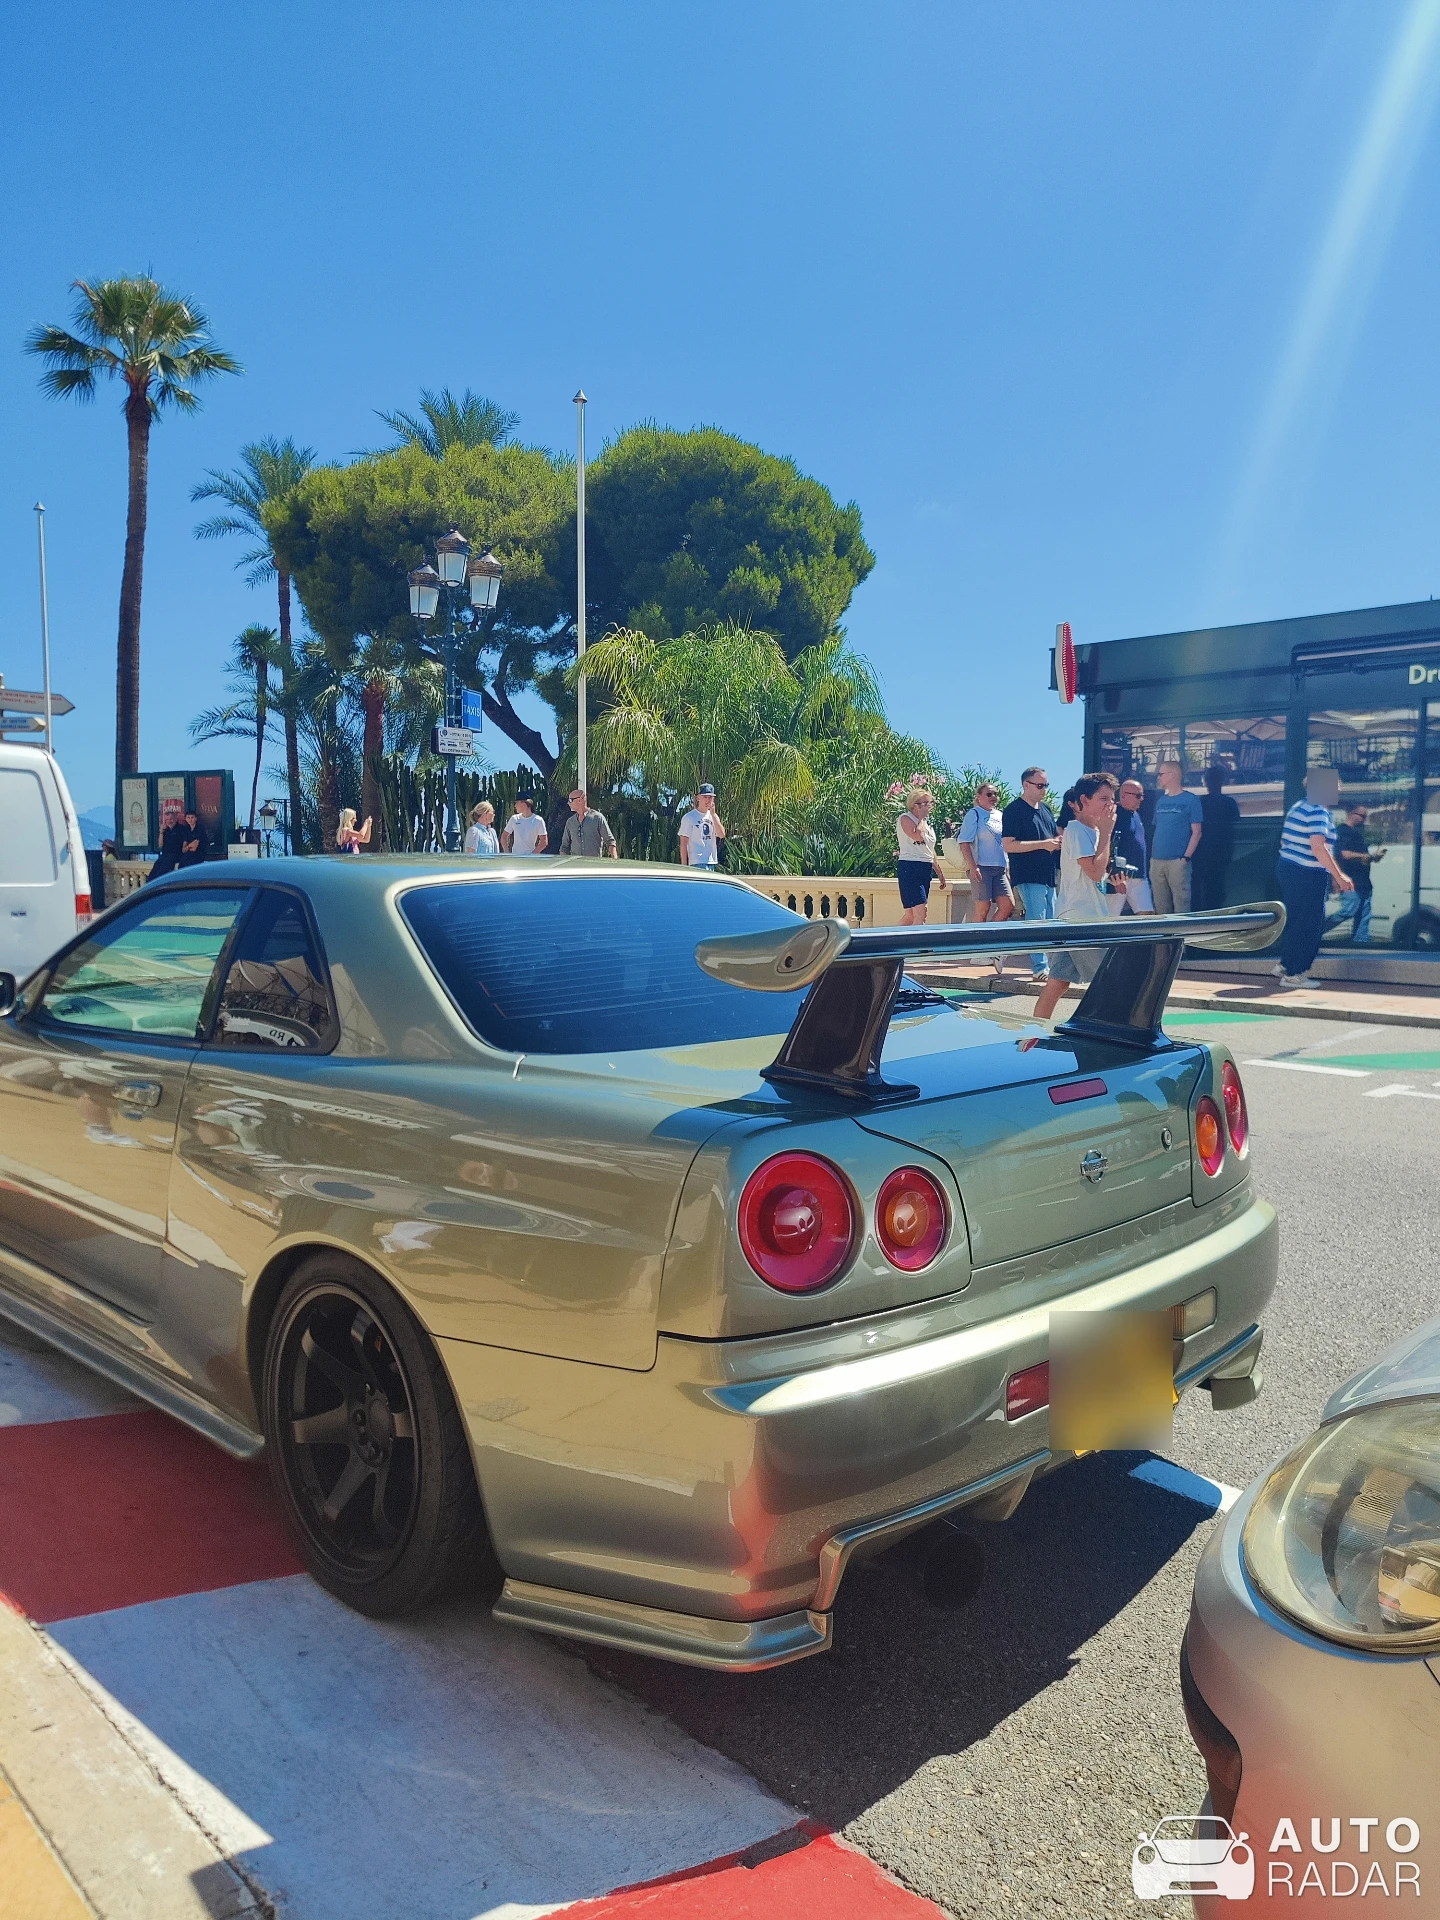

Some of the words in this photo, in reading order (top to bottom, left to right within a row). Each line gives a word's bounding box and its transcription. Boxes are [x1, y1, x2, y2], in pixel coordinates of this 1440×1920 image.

[1409, 664, 1440, 685] Dr
[463, 704, 480, 717] TAXIS
[1000, 1206, 1176, 1290] SKYLINE
